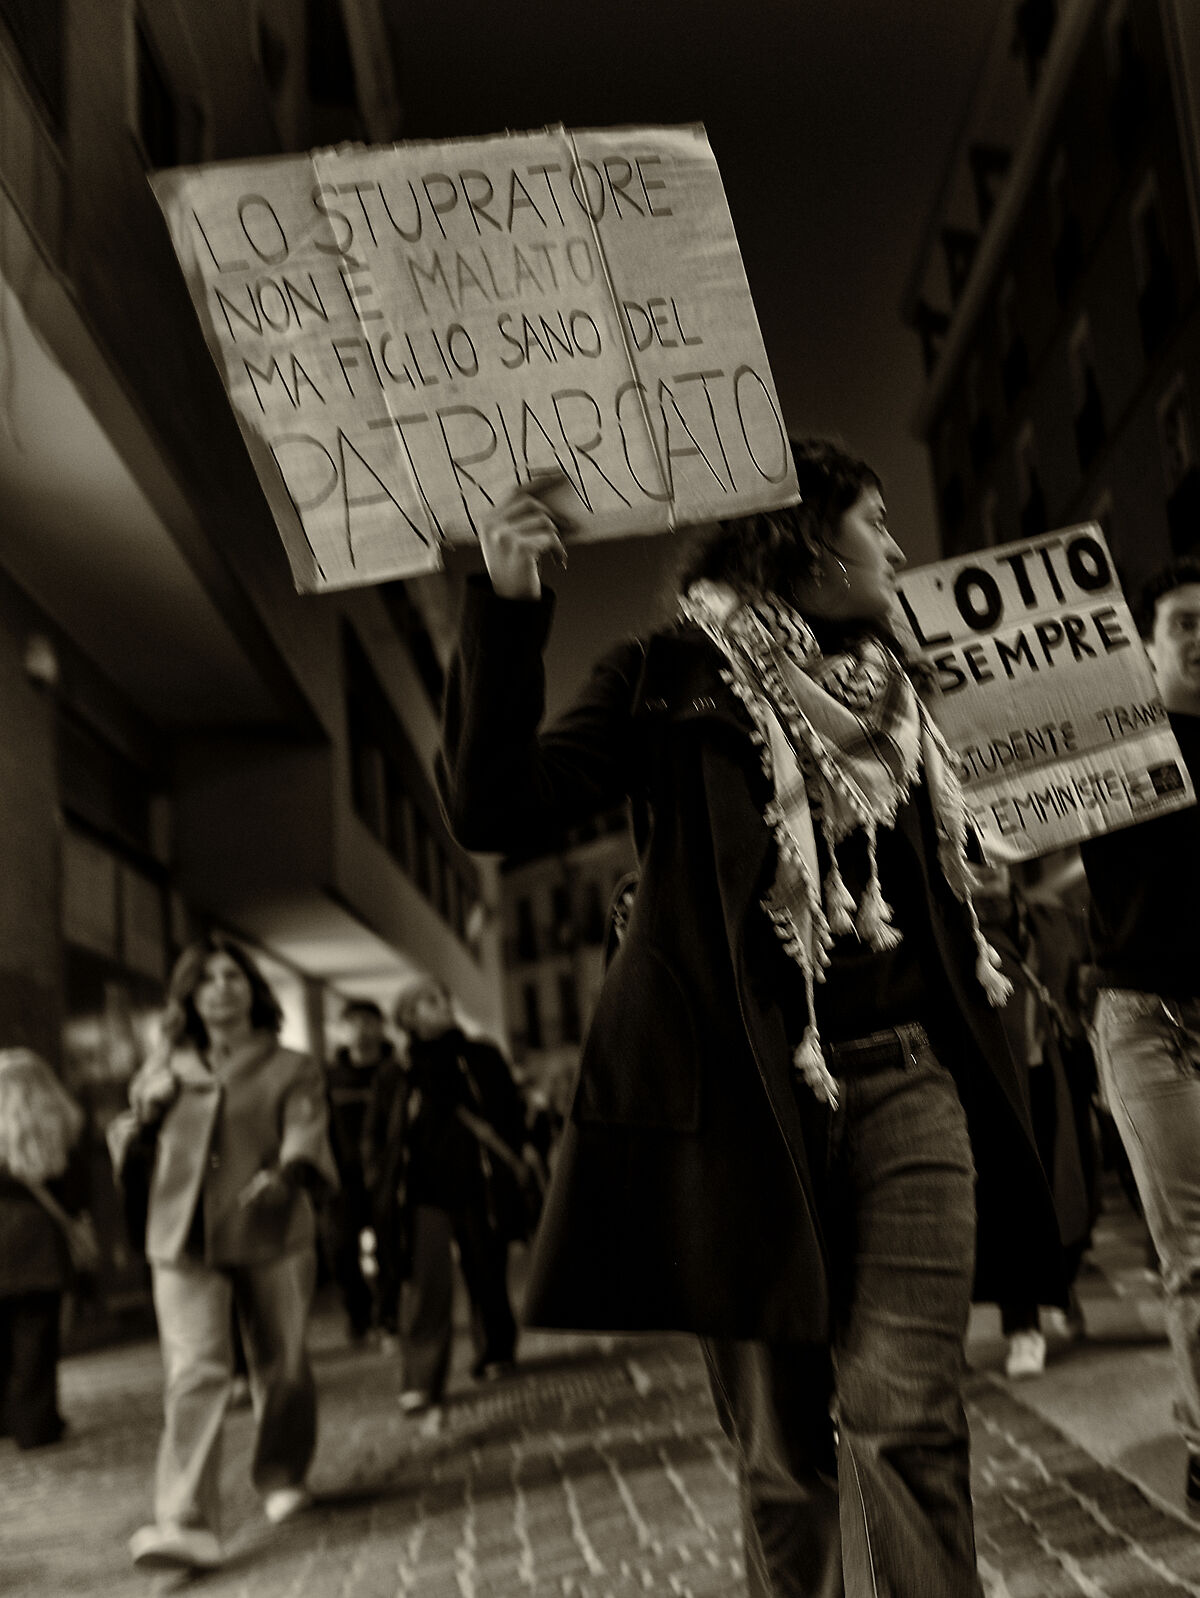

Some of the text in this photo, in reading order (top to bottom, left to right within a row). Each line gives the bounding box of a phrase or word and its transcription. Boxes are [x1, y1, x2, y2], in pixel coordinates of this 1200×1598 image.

[192, 155, 673, 273] LO STUPRATORE
[214, 271, 329, 342] NON
[407, 237, 595, 315] MALATO
[243, 297, 703, 414] MA FIGLIO SANO DEL
[268, 364, 788, 582] PATRIARCATO
[897, 537, 1111, 647] L'OTTO
[934, 606, 1130, 695] SEMPRE
